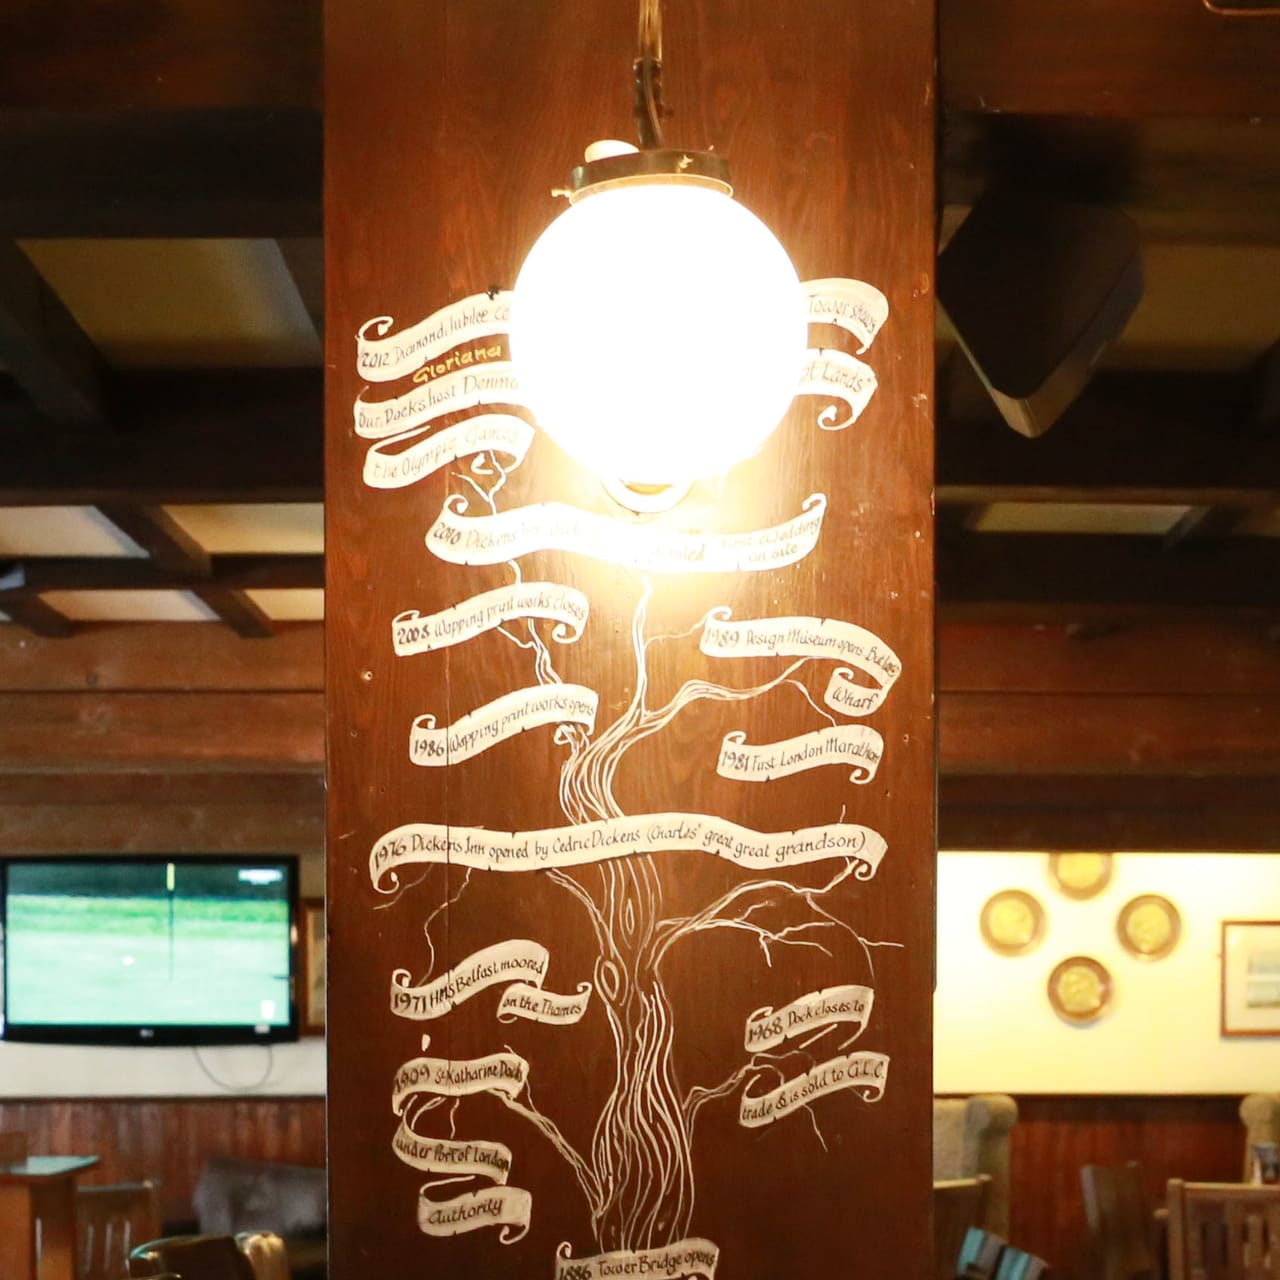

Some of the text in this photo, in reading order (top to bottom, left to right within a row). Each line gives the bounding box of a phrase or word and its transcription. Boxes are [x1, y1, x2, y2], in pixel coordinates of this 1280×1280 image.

[361, 352, 390, 368] 2012
[394, 325, 445, 363] Diamond
[412, 344, 502, 384] Gloriana
[384, 399, 426, 424] Docks
[428, 385, 457, 410] host
[402, 437, 457, 478] Olympic
[433, 522, 461, 545] 2010
[465, 530, 518, 549] Dickens
[434, 610, 484, 638] Wapping
[487, 597, 514, 620] print
[517, 592, 550, 609] works
[552, 593, 586, 621] closes
[705, 628, 739, 648] 1989
[746, 629, 784, 651] Design
[787, 626, 836, 647] Museum
[837, 638, 864, 657] opens
[832, 686, 879, 710] Wharf
[414, 739, 445, 757] 1986
[448, 724, 499, 754] Wapping
[501, 701, 528, 730] print
[531, 696, 567, 713] works
[721, 737, 879, 772] 1981 First London Marathon
[374, 840, 407, 869] 1976
[411, 833, 463, 852] Dickens
[489, 844, 529, 863] opened
[535, 845, 549, 861] by
[552, 833, 591, 855] Cedric
[591, 829, 641, 849] Dickens
[704, 828, 733, 850] great
[733, 840, 770, 859] great
[775, 831, 866, 863] grandson)
[394, 958, 544, 1013] 1971 HMS Belfast moored
[502, 994, 582, 1017] on the Thames
[748, 1000, 864, 1043] 1968 Dock closes to
[394, 1065, 430, 1092] 1909
[445, 1063, 499, 1085] Katharine
[742, 1101, 773, 1120] trade
[789, 1090, 800, 1104] is
[801, 1072, 827, 1097] sold
[831, 1068, 844, 1081] to
[396, 1138, 509, 1171] under Port of London
[598, 1260, 638, 1277] Tower
[638, 1254, 683, 1277] Bridge
[684, 1251, 716, 1267] opens
